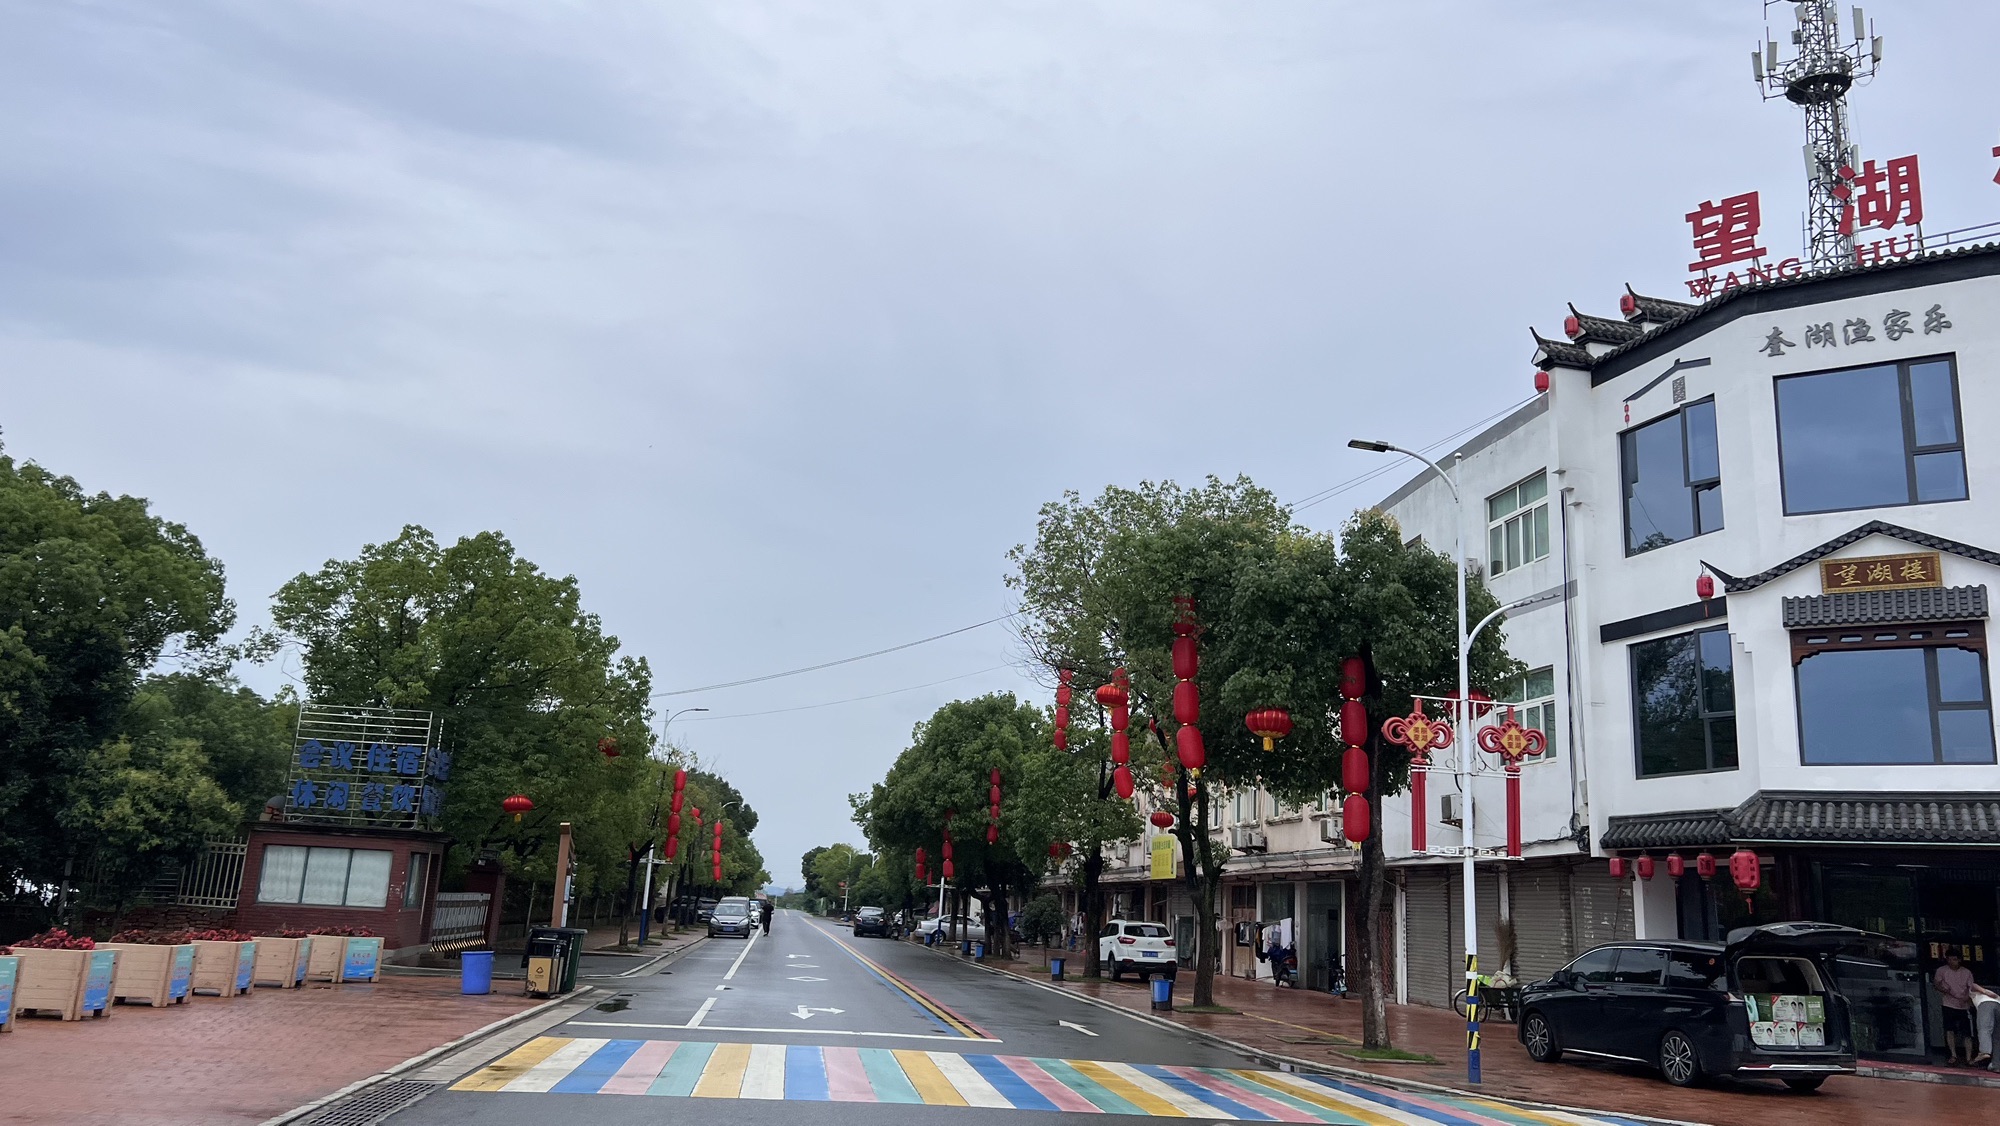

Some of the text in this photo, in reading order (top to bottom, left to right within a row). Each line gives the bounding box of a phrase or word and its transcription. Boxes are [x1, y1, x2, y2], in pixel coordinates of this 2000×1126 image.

[1684, 233, 1915, 299] WANG HU
[299, 738, 356, 771] 会议
[366, 743, 422, 775] 住宿
[292, 779, 350, 812] 休闲
[360, 781, 417, 814] 餐饮
